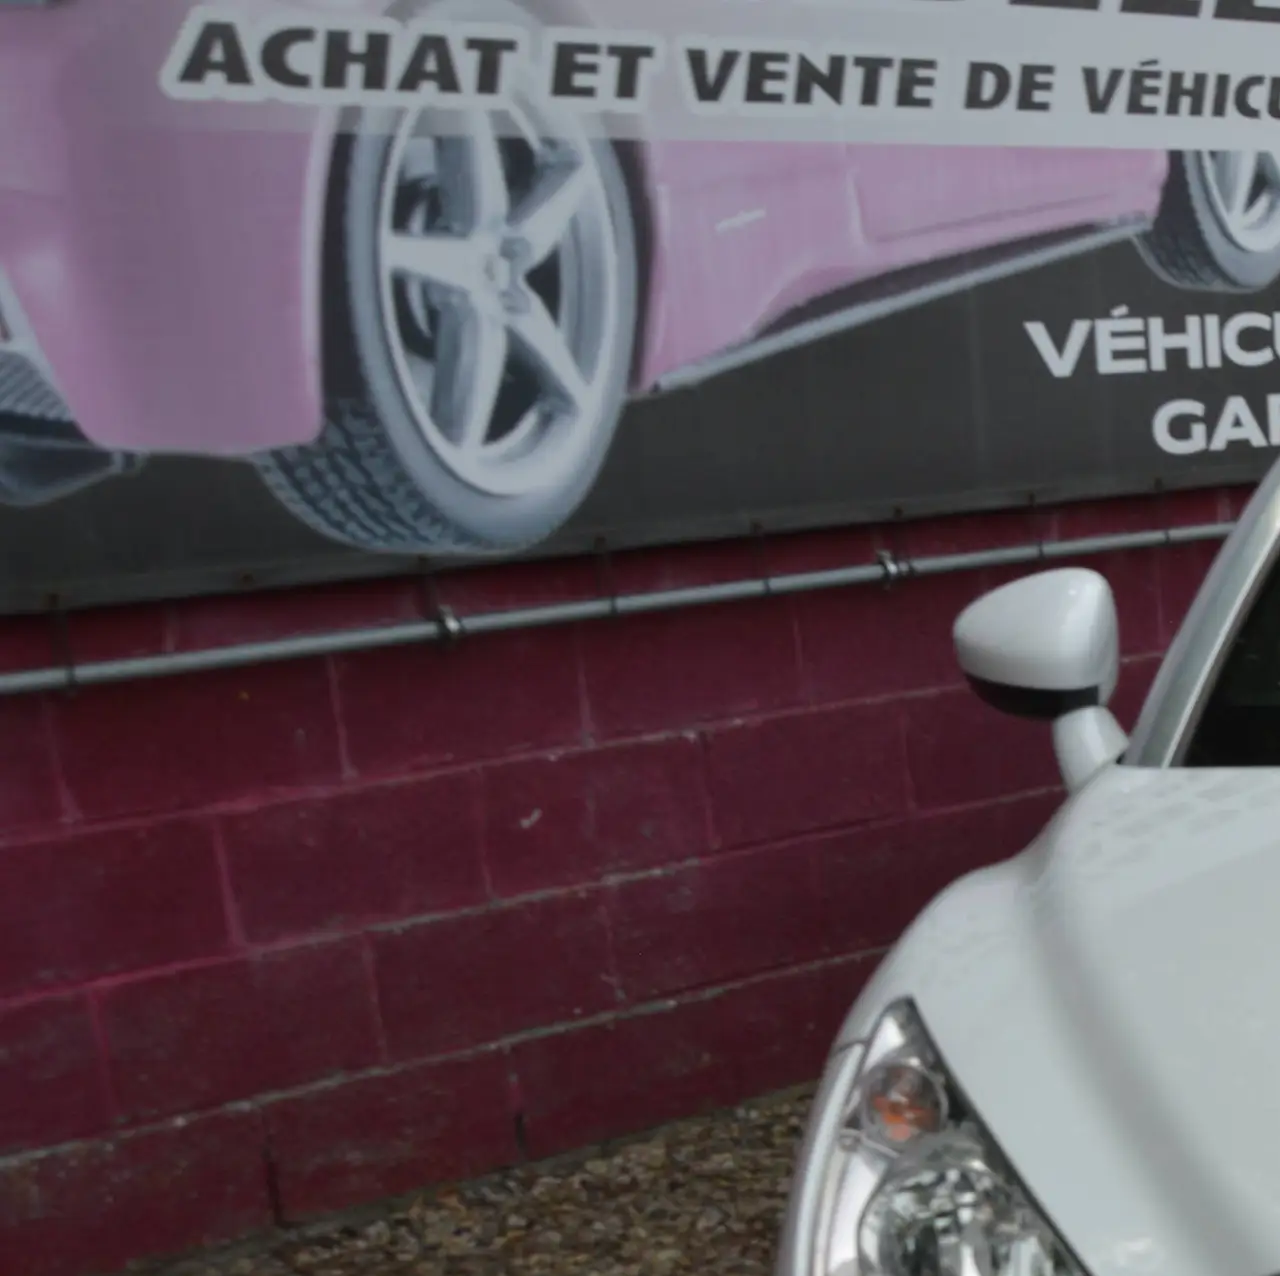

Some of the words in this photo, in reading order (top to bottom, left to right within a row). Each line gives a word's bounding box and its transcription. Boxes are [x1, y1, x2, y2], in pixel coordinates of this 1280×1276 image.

[176, 21, 518, 95] ACHAT
[550, 42, 655, 99] ET
[686, 48, 938, 107] VENTE
[963, 61, 1056, 112] DE
